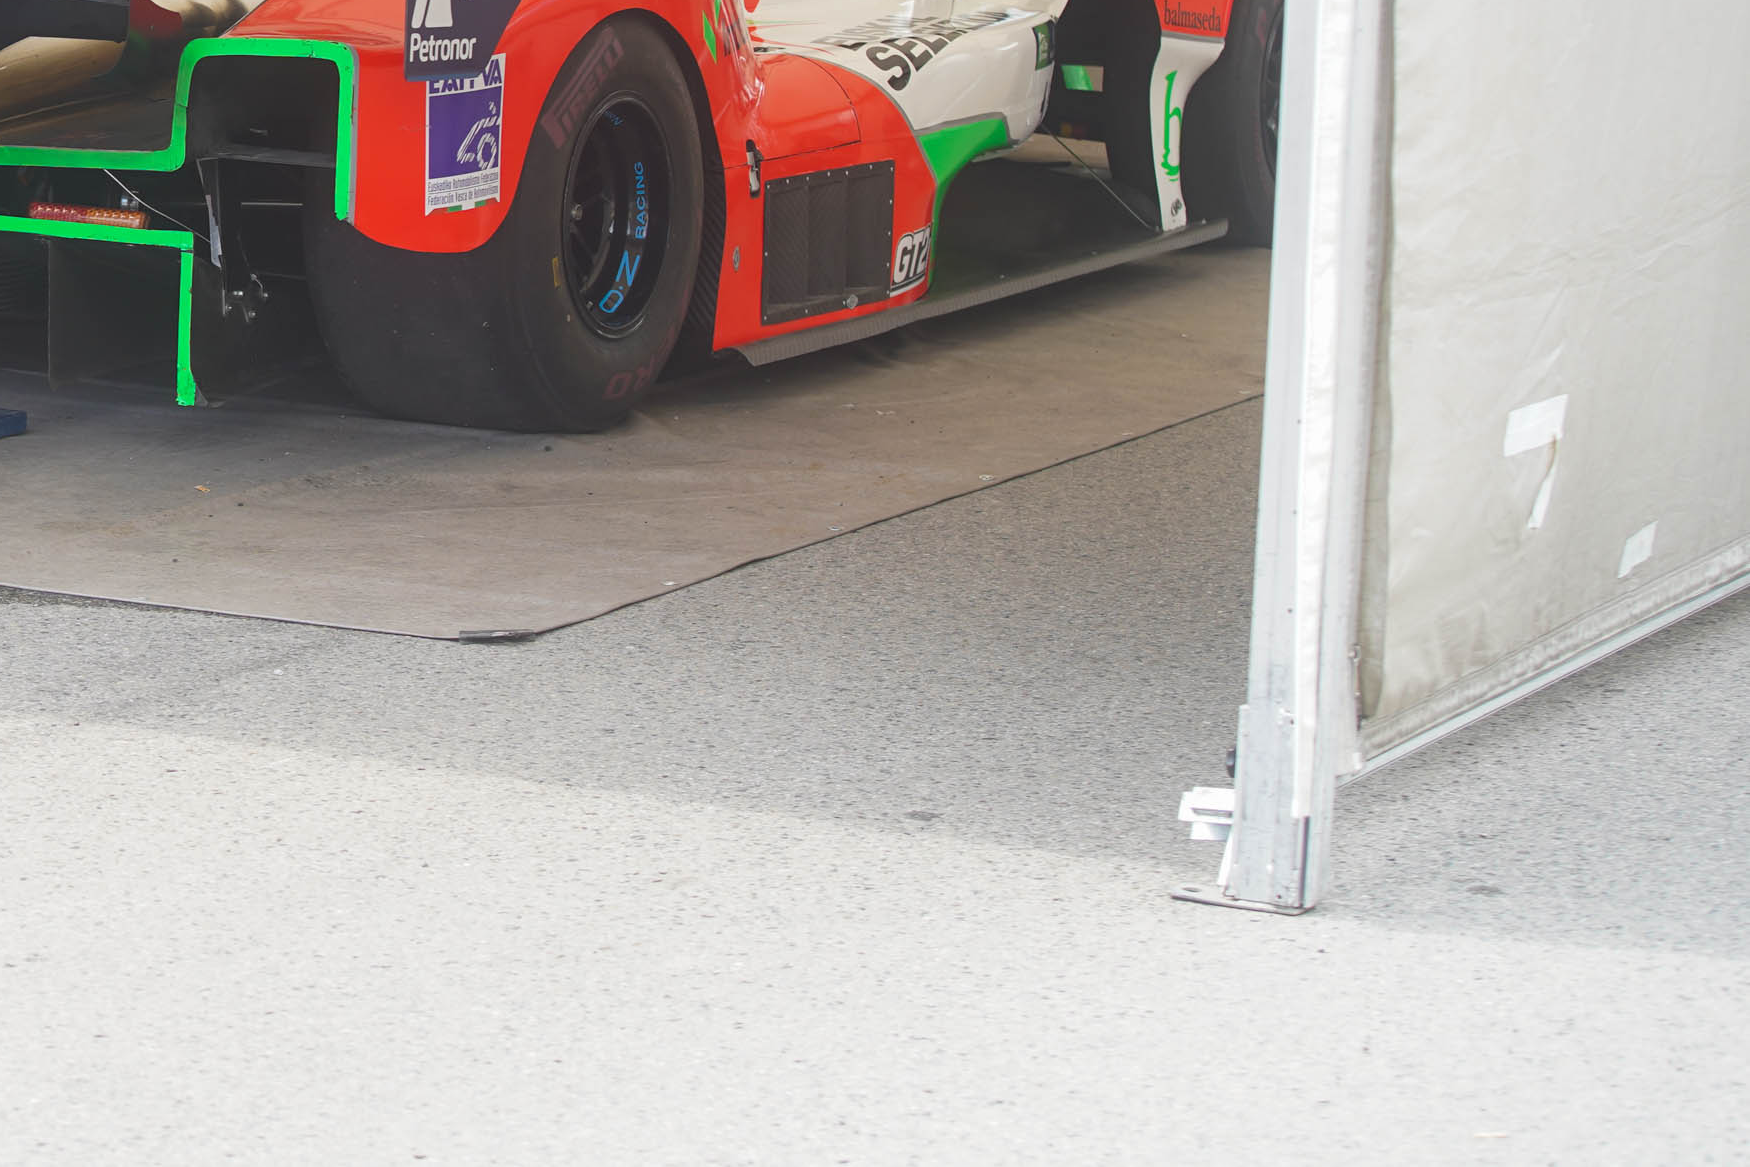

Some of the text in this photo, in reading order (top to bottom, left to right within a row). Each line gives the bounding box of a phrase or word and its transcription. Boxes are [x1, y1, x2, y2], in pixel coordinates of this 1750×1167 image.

[1163, 0, 1221, 32] balmaseda
[409, 32, 477, 63] Petronor
[633, 161, 647, 239] RACING
